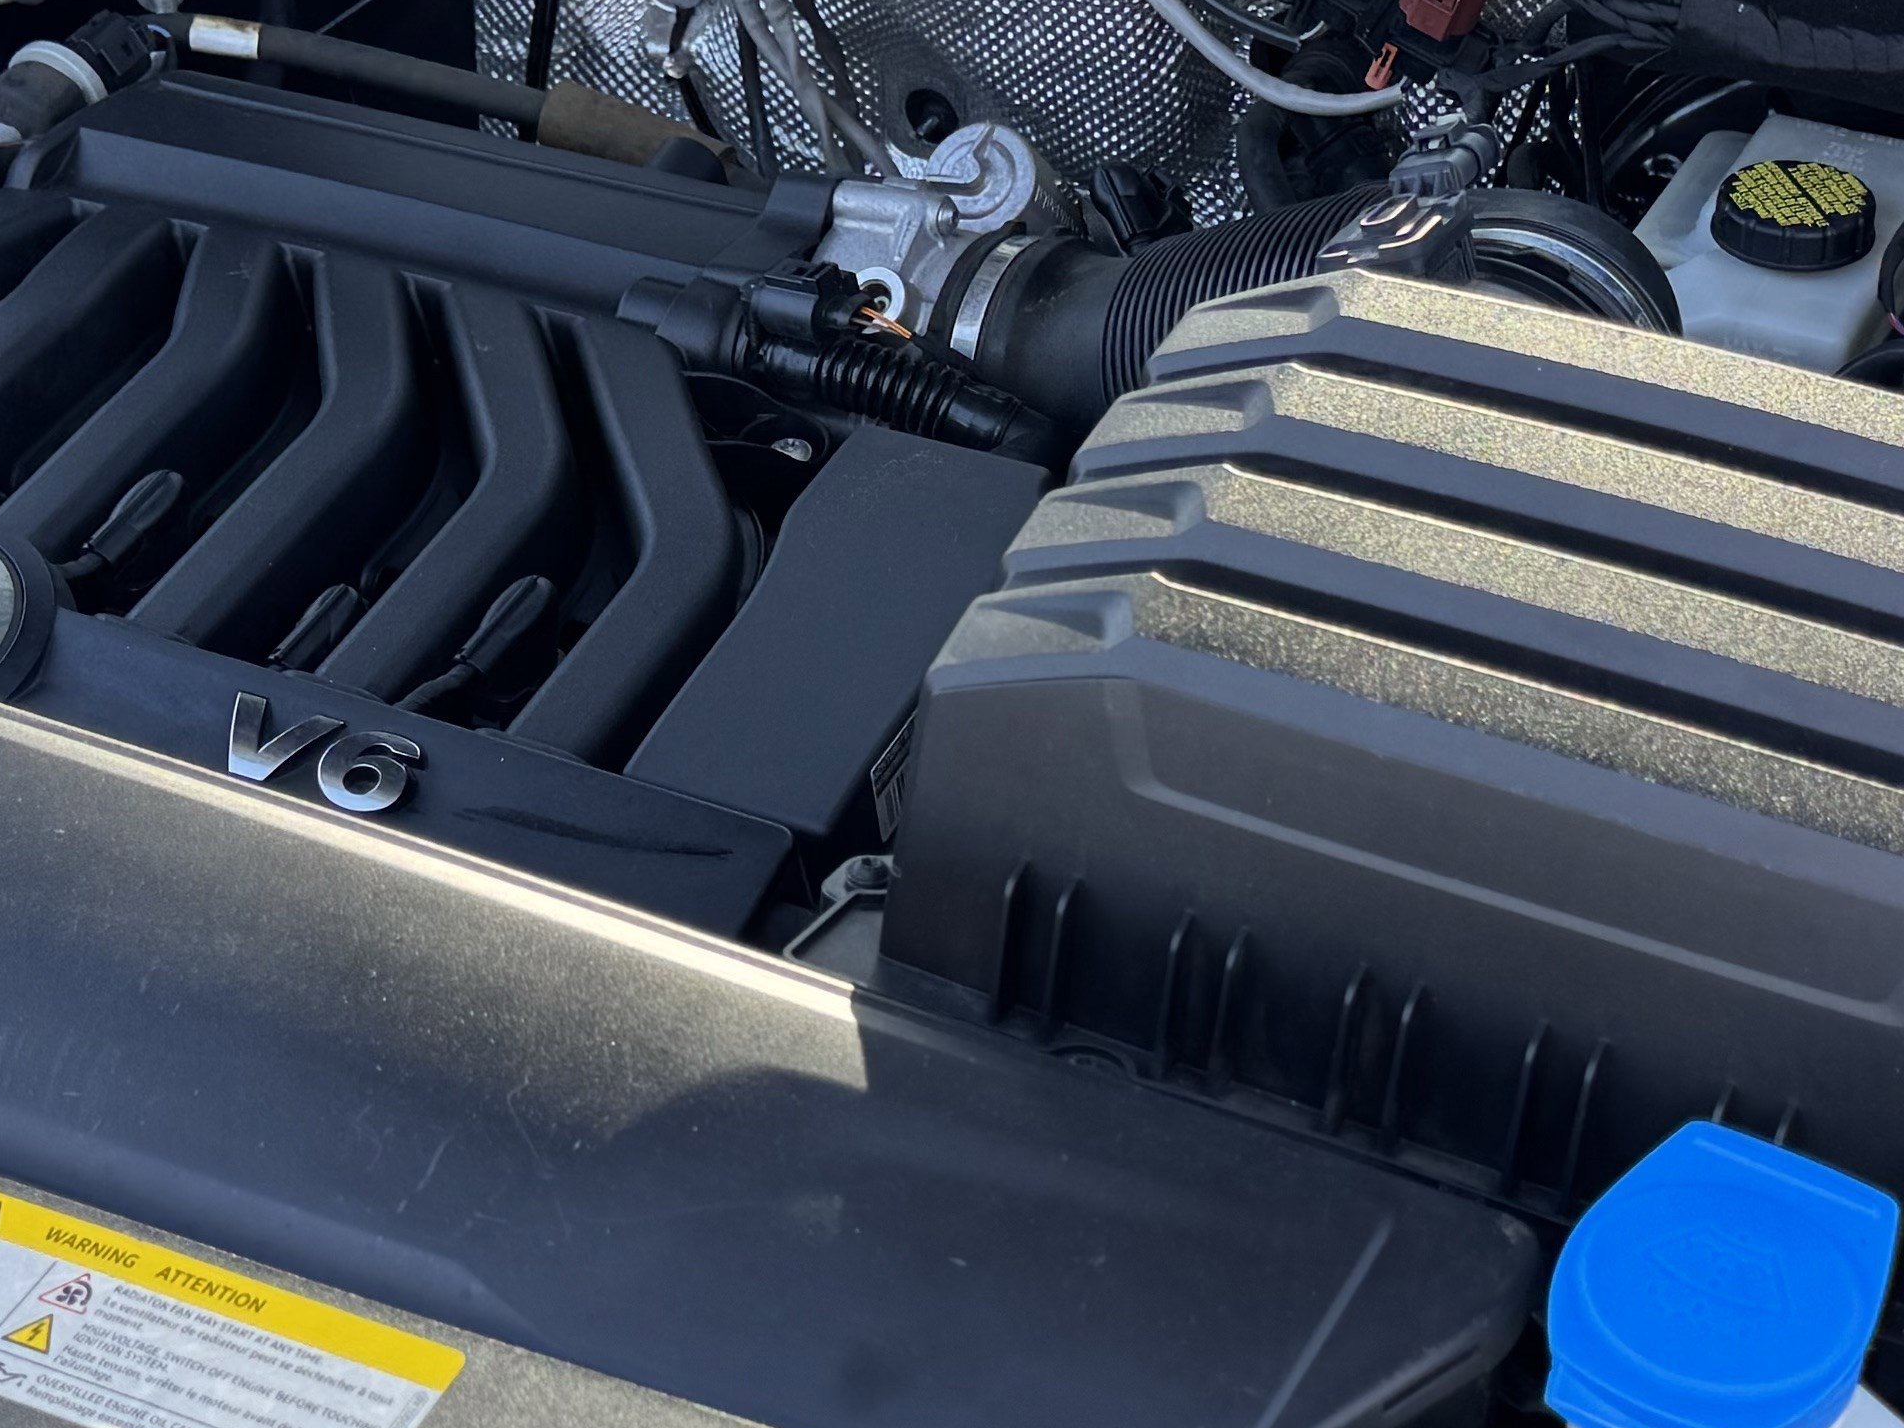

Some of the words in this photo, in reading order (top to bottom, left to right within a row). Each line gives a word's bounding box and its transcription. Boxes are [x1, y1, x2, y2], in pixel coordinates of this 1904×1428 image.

[227, 691, 421, 812] V6
[41, 1226, 141, 1269] WARNING
[153, 1264, 268, 1312] ATTENTION
[71, 1332, 125, 1355] IGNITION
[111, 1285, 171, 1310] RADIATOR
[168, 1304, 194, 1318] FAN
[192, 1313, 220, 1327] MAY
[218, 1321, 255, 1339] START
[269, 1339, 295, 1353] ANY
[116, 1303, 180, 1330] ventilateur
[195, 1330, 250, 1355] radiateur
[78, 1322, 111, 1339] HIGH
[160, 1351, 209, 1373] SWITCH
[205, 1367, 231, 1381] OFF
[228, 1375, 274, 1396] ENGINE
[273, 1390, 320, 1413] BEFORE
[102, 1398, 149, 1420] ENGINE
[146, 1414, 169, 1427] OIL
[196, 1392, 243, 1415] moteur
[241, 1408, 278, 1427] avant
